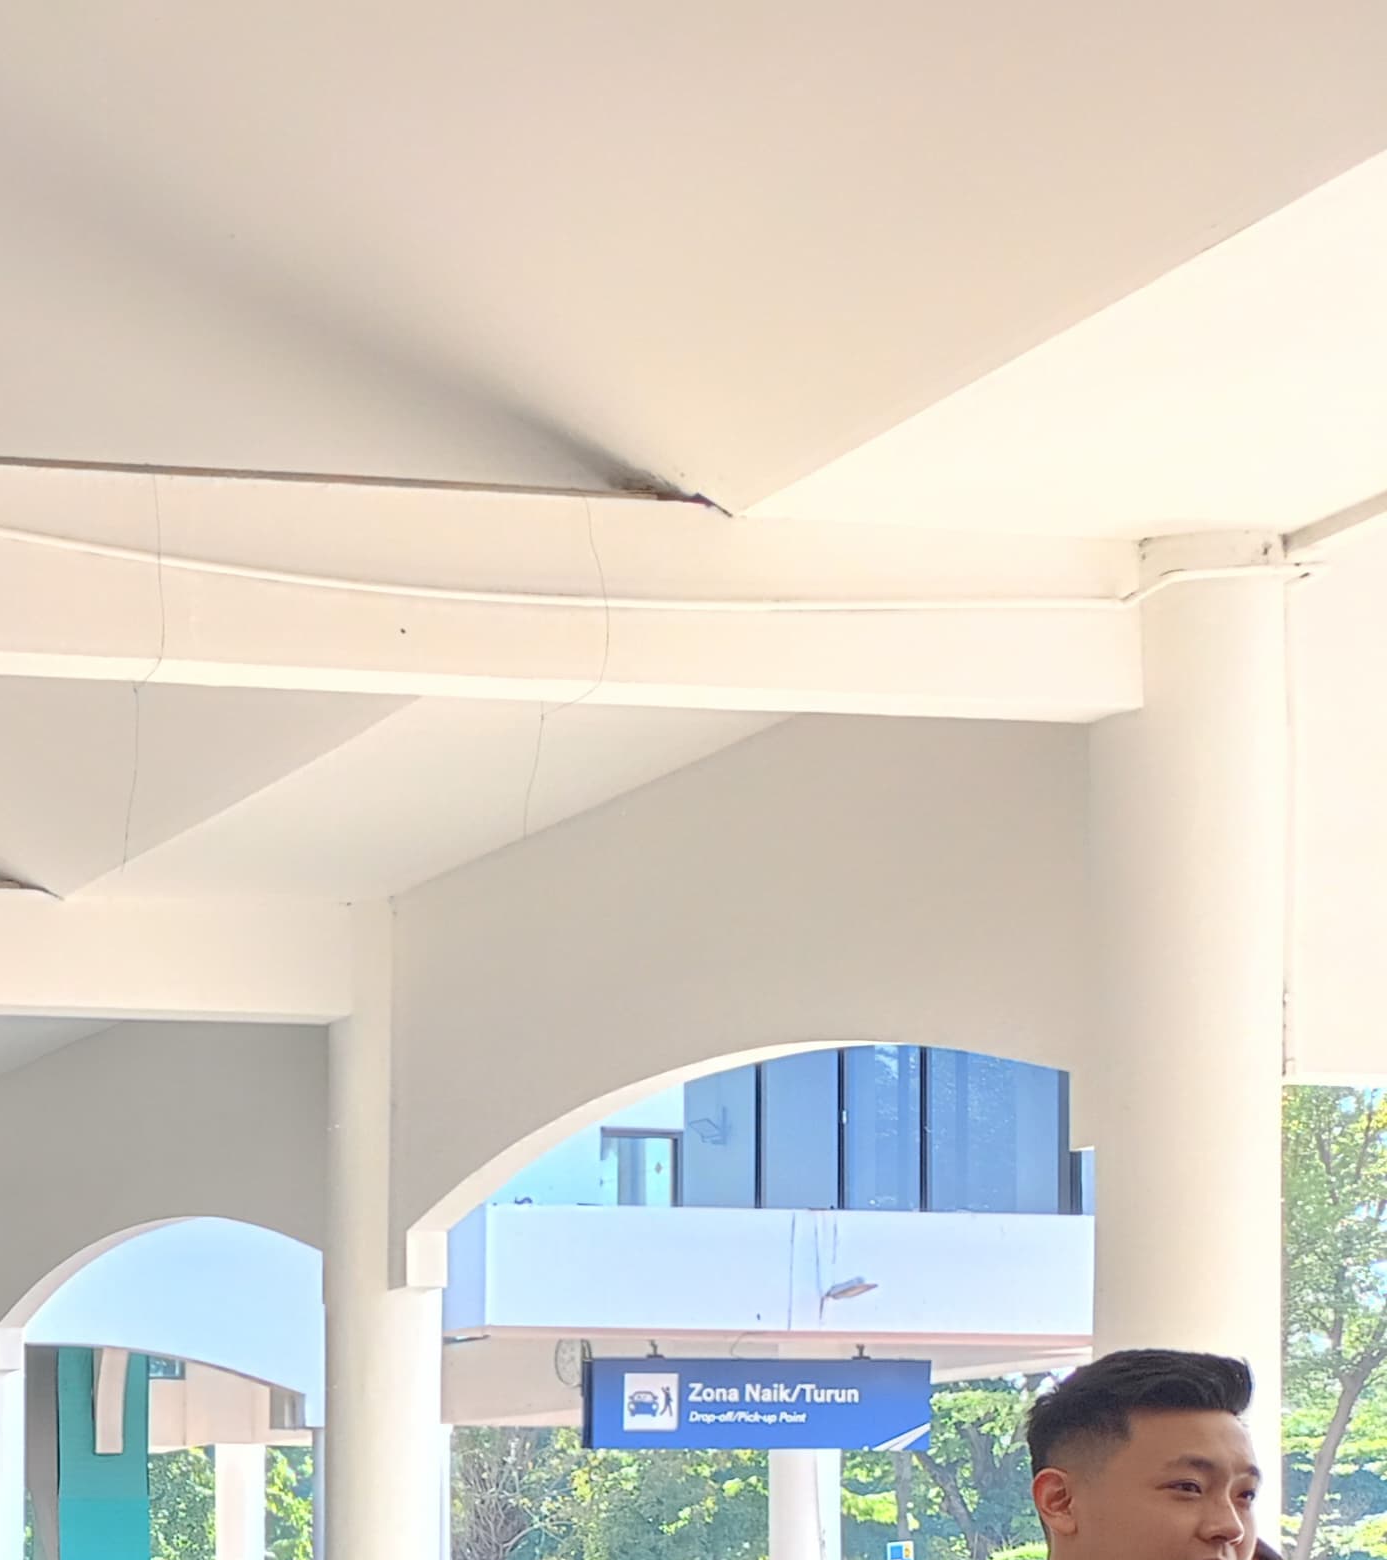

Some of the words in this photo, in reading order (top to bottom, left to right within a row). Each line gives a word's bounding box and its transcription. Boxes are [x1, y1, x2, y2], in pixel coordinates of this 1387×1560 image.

[688, 1383, 740, 1403] Zona
[745, 1383, 860, 1403] Naik/Turun
[779, 1411, 807, 1423] Point
